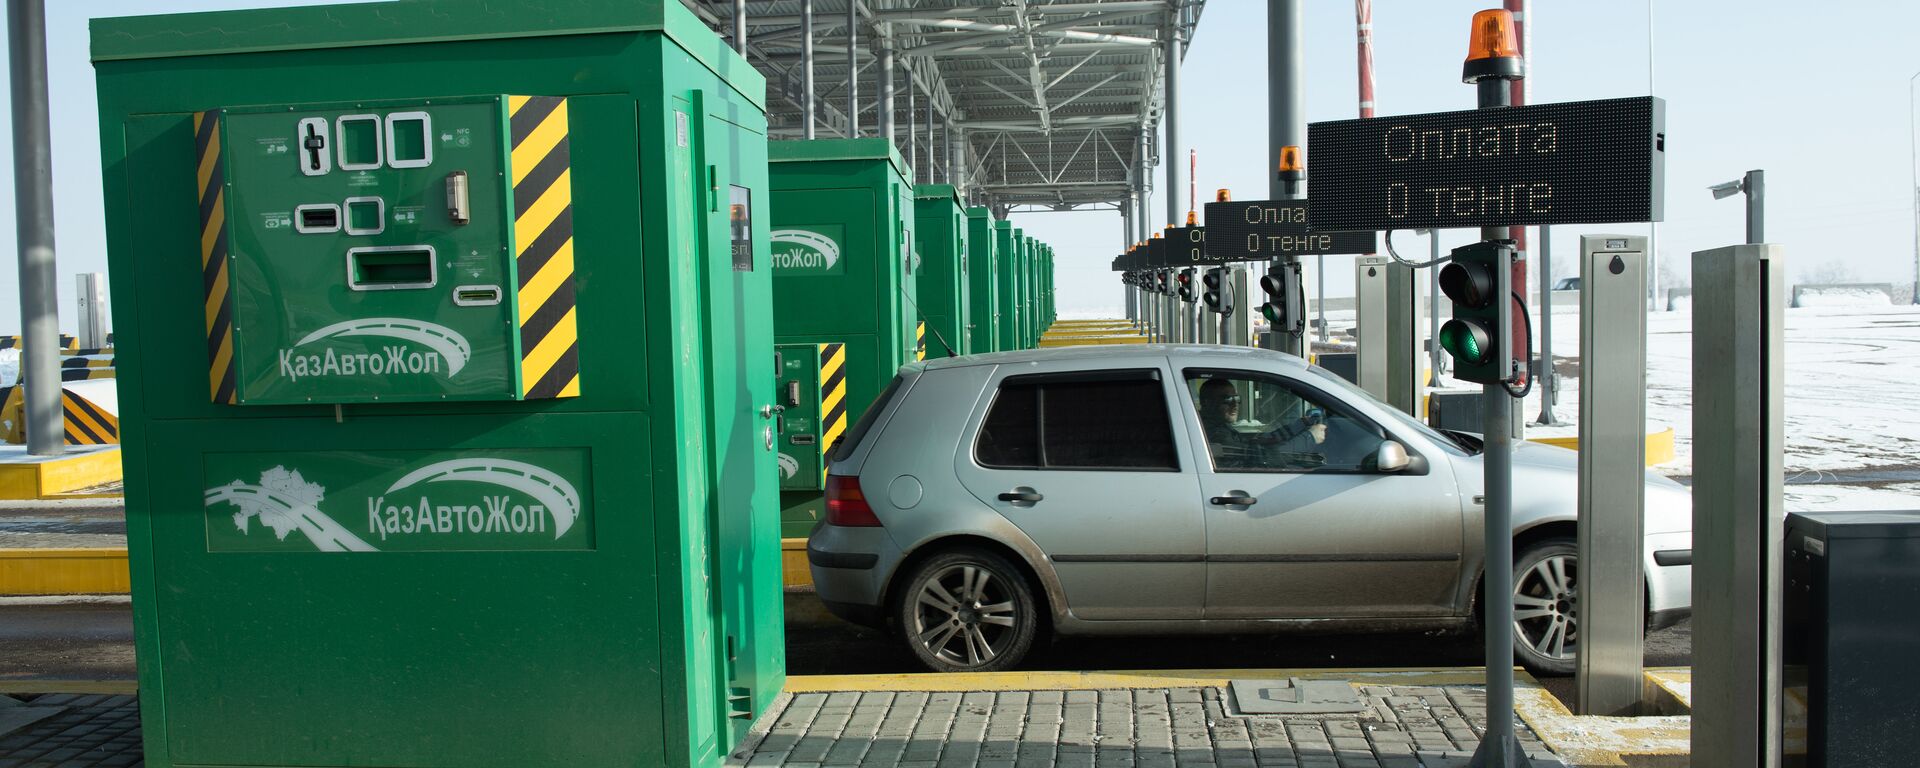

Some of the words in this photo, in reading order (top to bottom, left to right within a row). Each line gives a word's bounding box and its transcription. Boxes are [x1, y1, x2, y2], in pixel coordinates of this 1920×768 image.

[1384, 122, 1557, 162] Оплата
[1245, 205, 1306, 224] Опла
[1387, 182, 1409, 219] 0
[1424, 182, 1552, 217] тенге
[770, 247, 822, 268] втоЖол
[1247, 233, 1260, 252] 0
[1267, 234, 1331, 252] тенге
[279, 345, 441, 382] ҚазАвтоЖол
[367, 495, 546, 541] ҚазАвтоЖол
